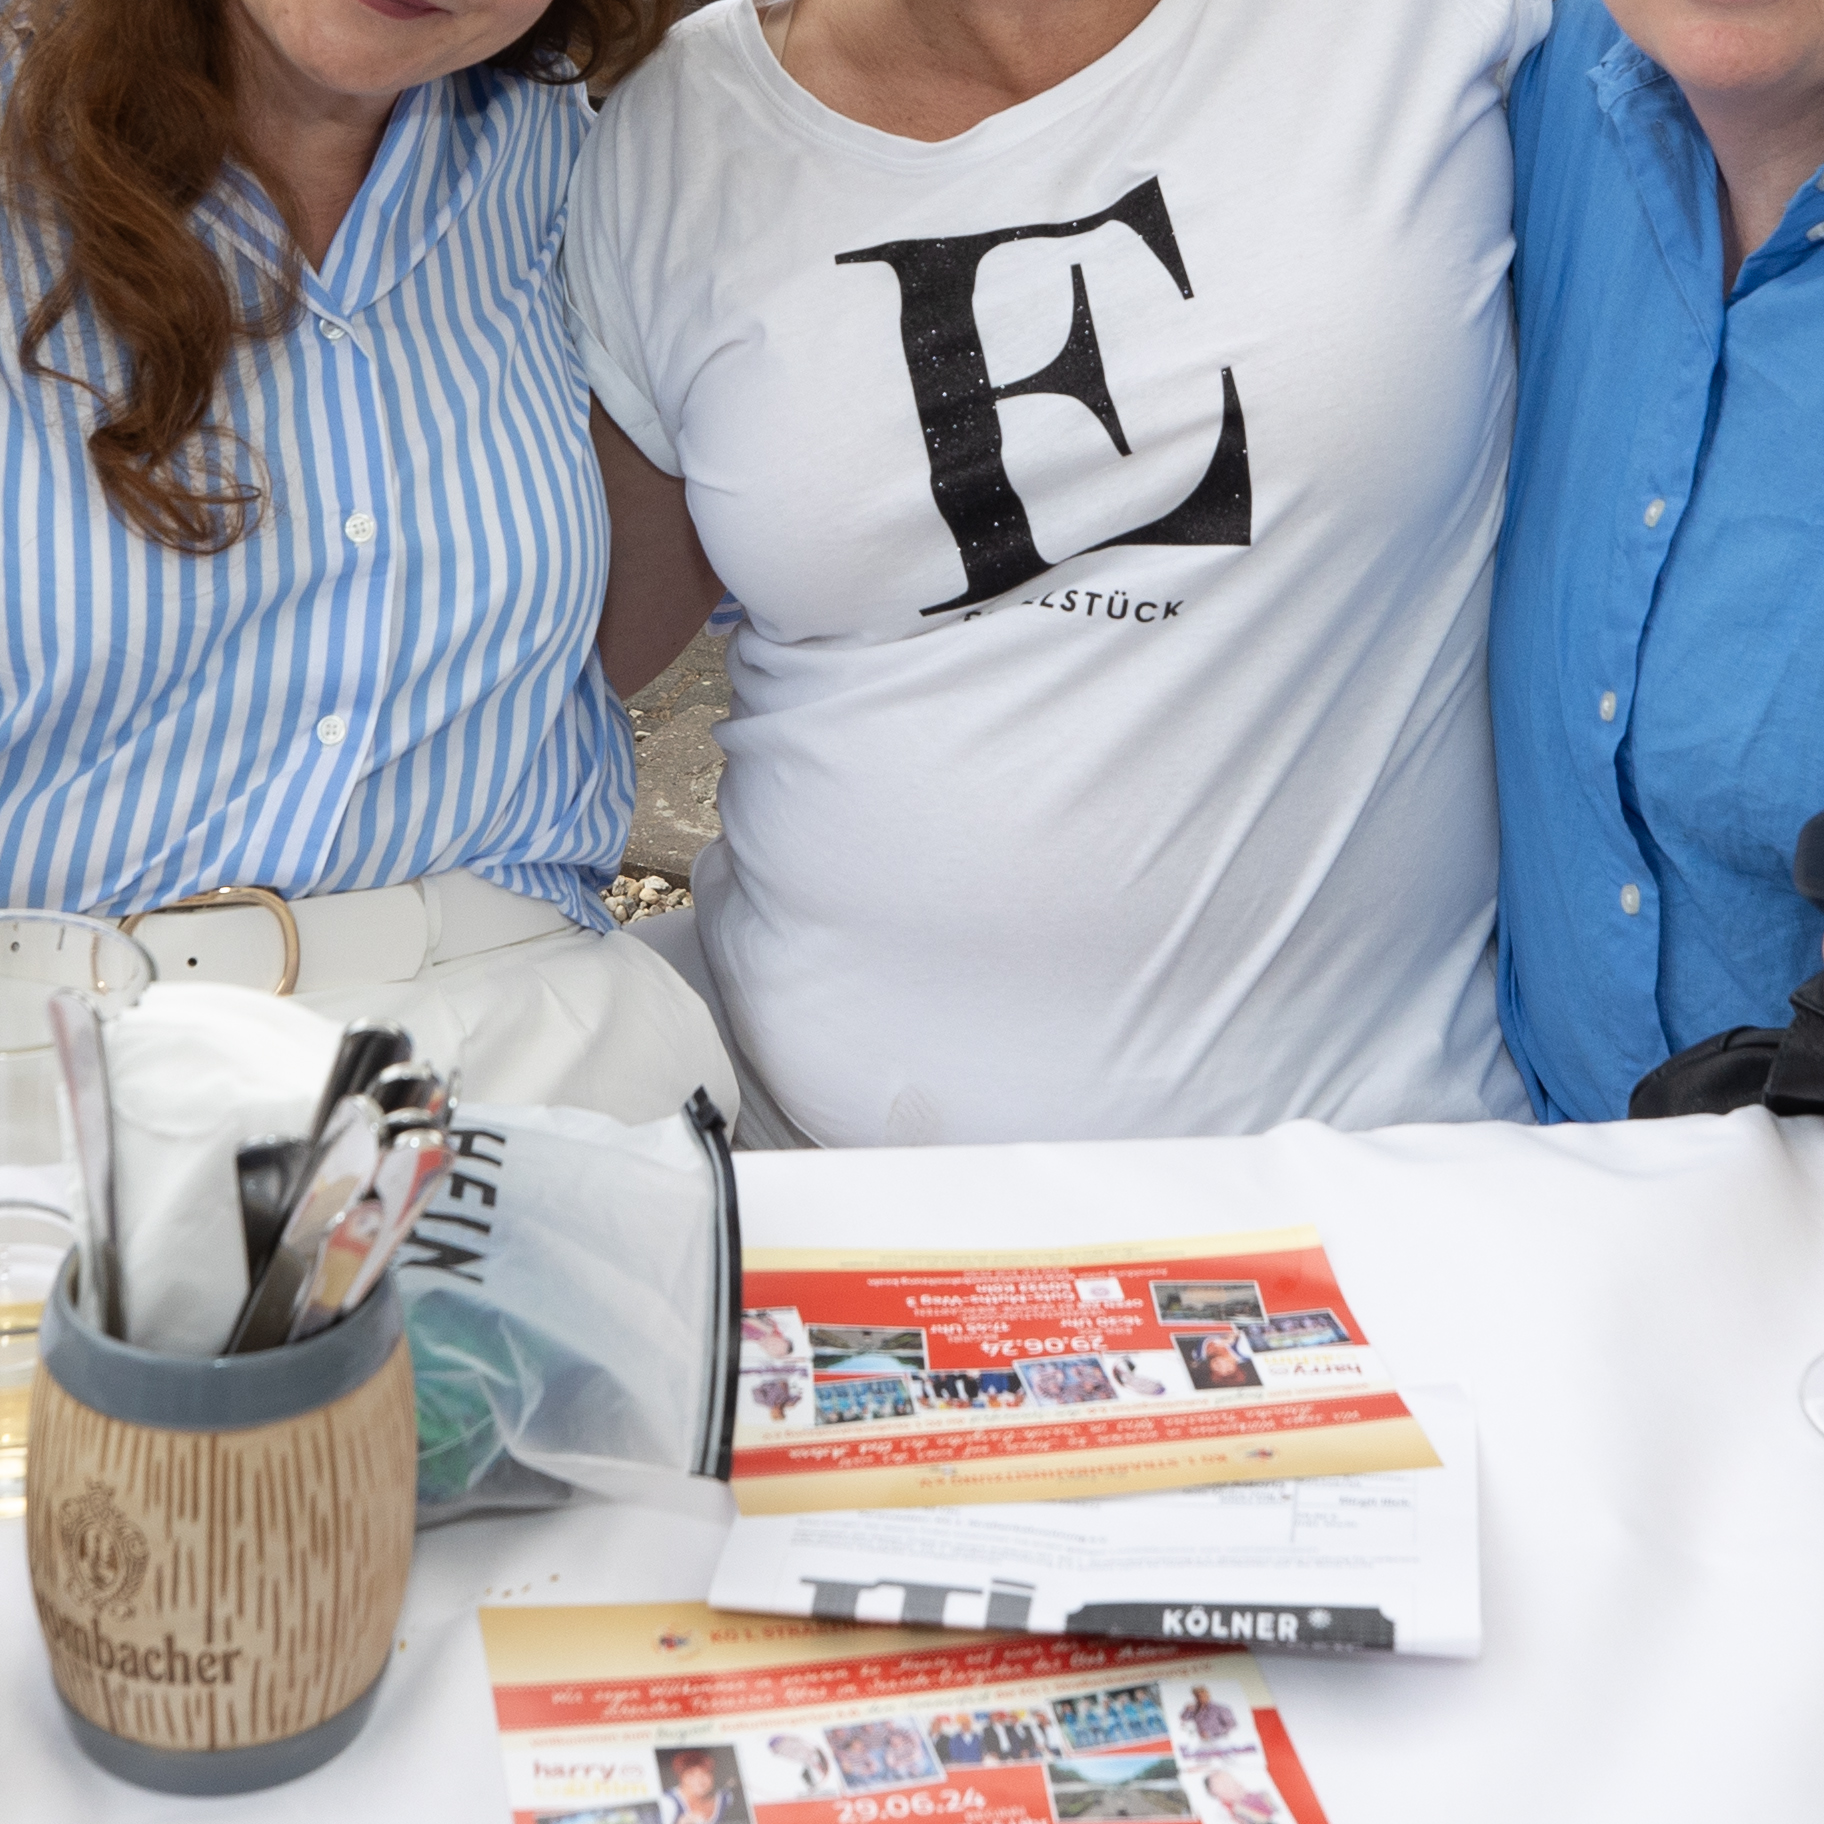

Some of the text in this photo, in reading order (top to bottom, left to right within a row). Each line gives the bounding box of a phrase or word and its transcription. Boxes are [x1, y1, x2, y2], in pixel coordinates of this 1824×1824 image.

[834, 175, 1252, 617] E
[980, 1335, 1110, 1358] 29.06.24
[1162, 1606, 1299, 1643] KÖLNER
[831, 1786, 988, 1824] 29.06.24
